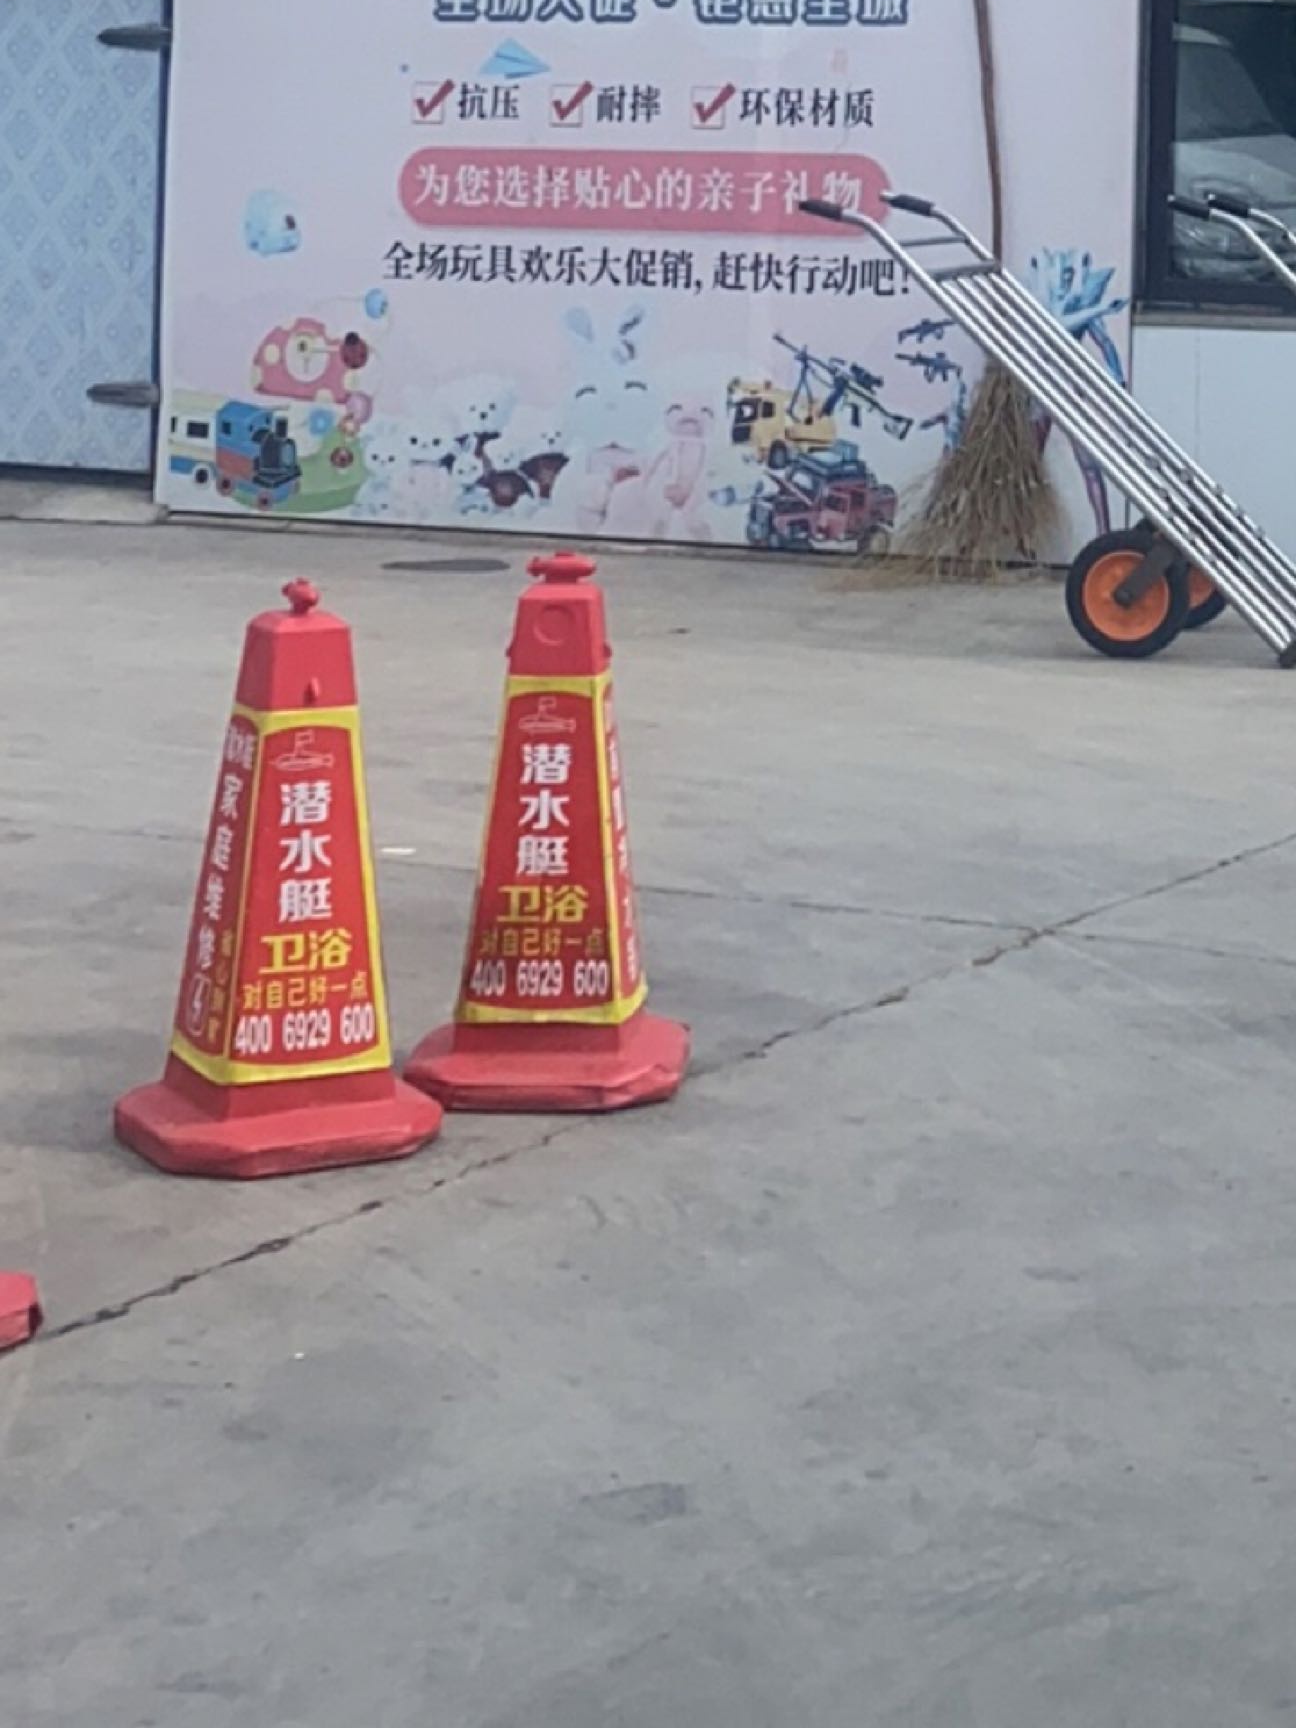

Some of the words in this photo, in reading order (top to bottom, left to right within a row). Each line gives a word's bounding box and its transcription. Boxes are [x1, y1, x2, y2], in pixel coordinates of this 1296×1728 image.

[457, 83, 520, 122] 抗压
[596, 85, 662, 124] 耐摔
[740, 88, 875, 128] 环保材质
[415, 164, 862, 213] 为您选择贴心的亲子礼物
[516, 743, 572, 877] 潜水艇
[279, 780, 333, 923] 潜水艇
[497, 884, 589, 924] 卫浴
[259, 928, 353, 975] 卫浴
[480, 928, 604, 957] 对自己好一点
[243, 971, 369, 1010] 对自己好一点
[470, 959, 506, 998] 400
[517, 958, 562, 998] 6929
[574, 958, 608, 997] 600
[235, 1014, 272, 1056] 400
[282, 1008, 331, 1052] 6929
[340, 1002, 376, 1045] 600
